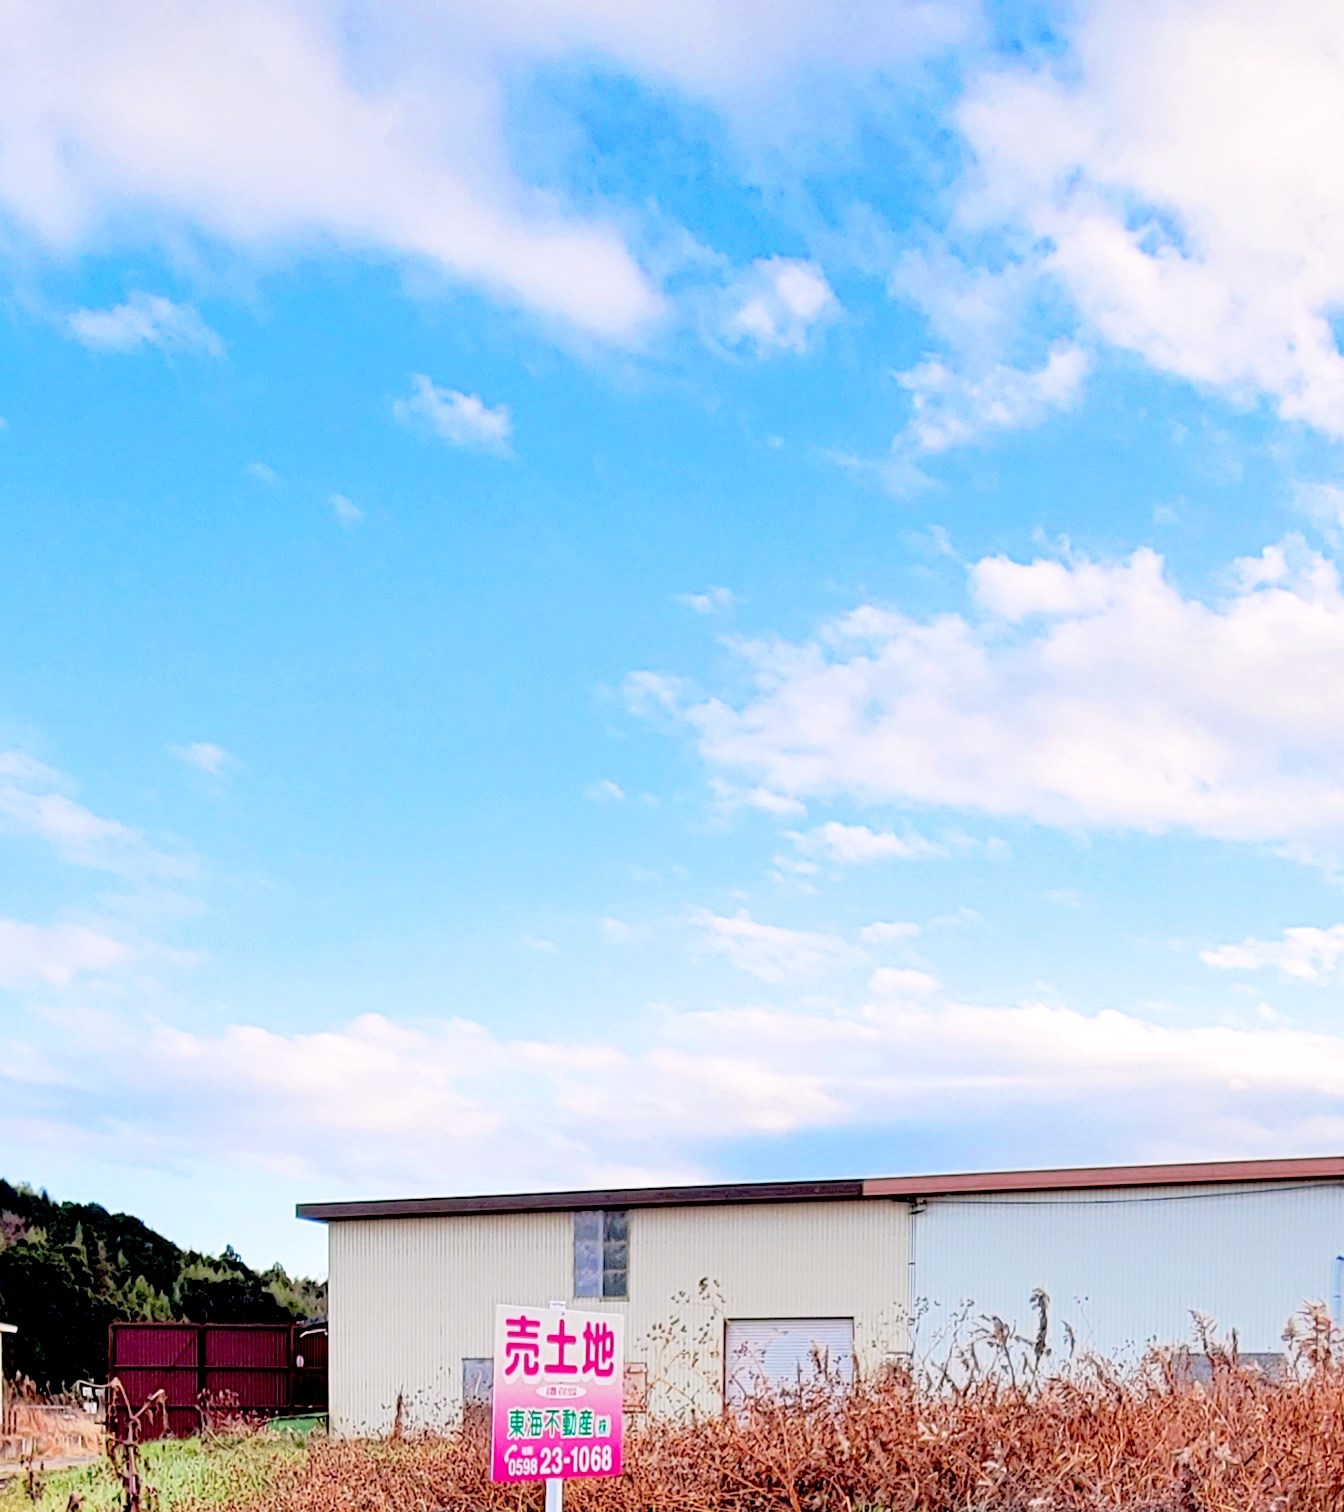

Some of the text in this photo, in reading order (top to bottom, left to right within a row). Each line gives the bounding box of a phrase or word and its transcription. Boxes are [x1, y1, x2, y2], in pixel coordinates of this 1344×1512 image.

[505, 1315, 614, 1377] 売土地
[509, 1409, 593, 1437] 東海不動産
[508, 1445, 612, 1476] 0598 23-1068
